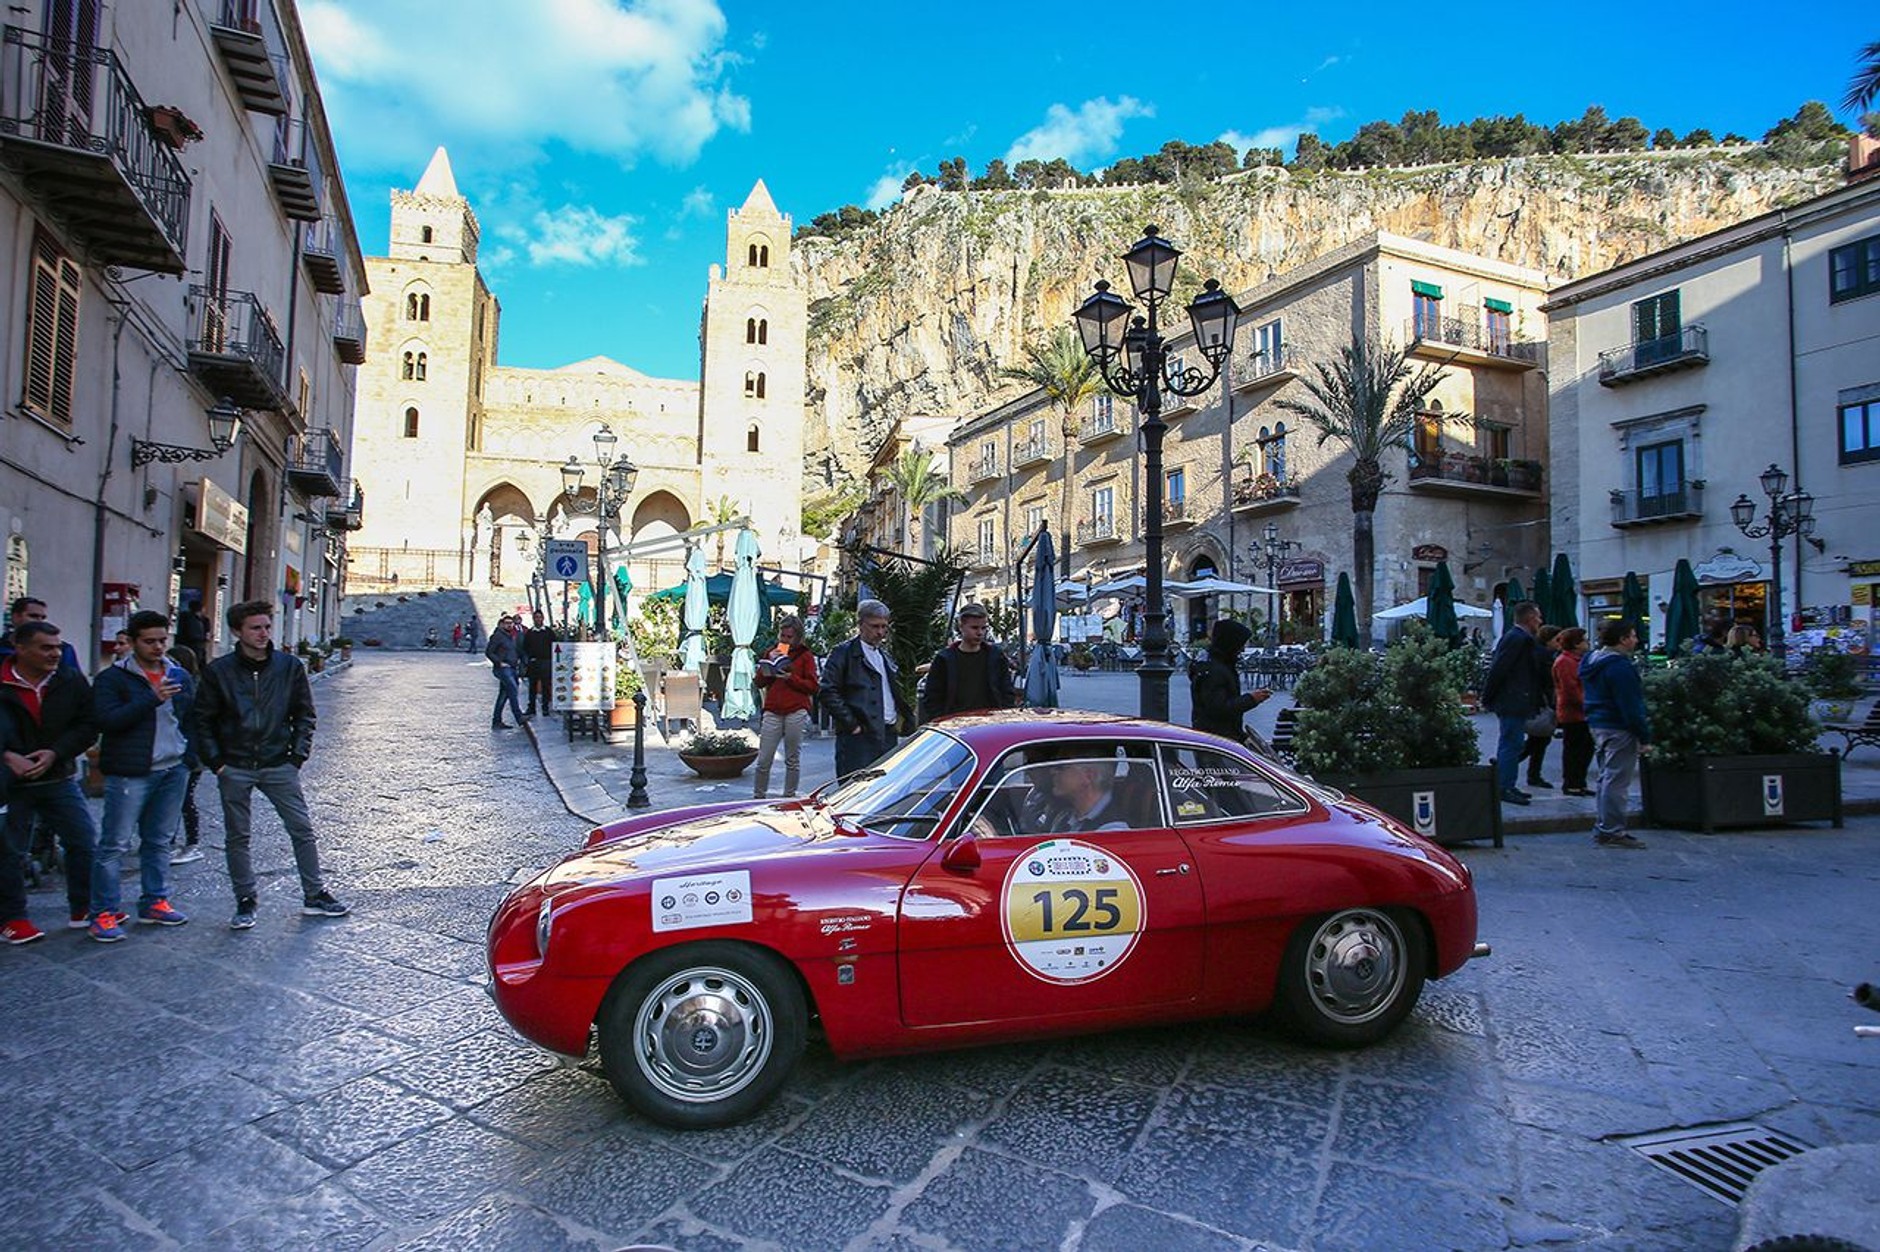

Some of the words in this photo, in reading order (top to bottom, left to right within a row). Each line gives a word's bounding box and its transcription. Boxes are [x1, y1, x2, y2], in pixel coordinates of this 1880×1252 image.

[1172, 776, 1202, 793] Alfa
[1202, 775, 1241, 788] Romeo
[1033, 888, 1121, 933] 125
